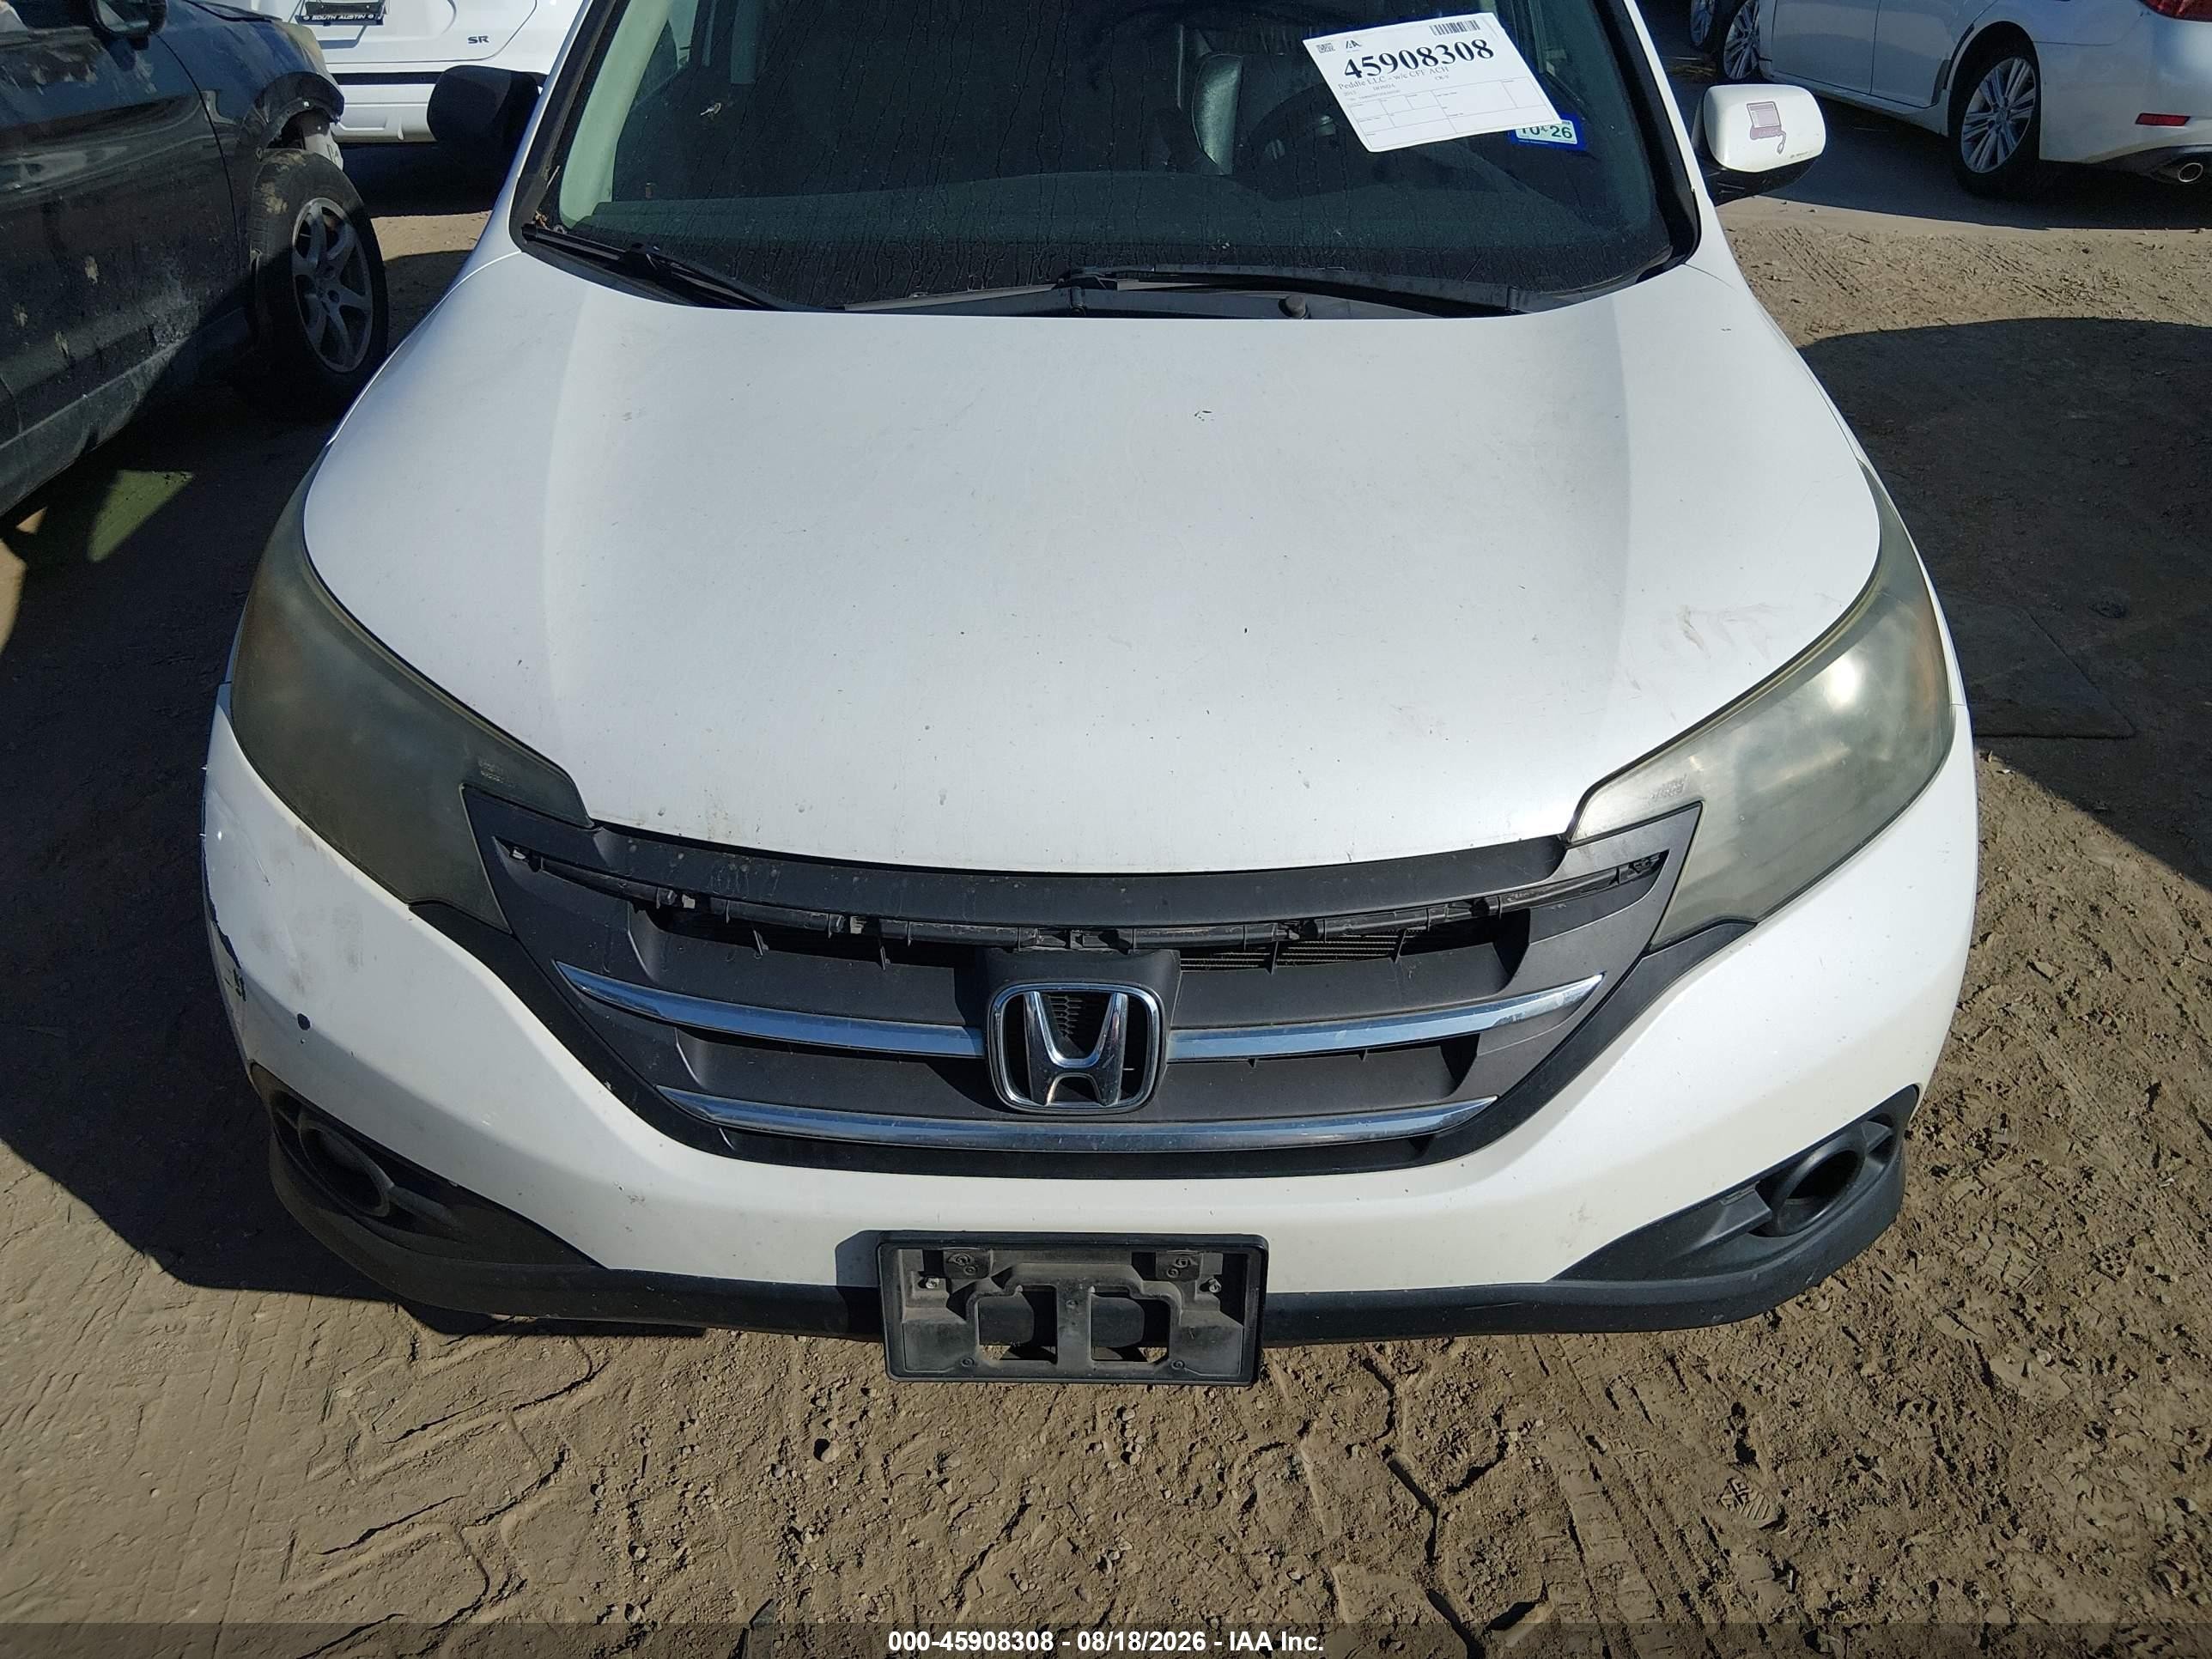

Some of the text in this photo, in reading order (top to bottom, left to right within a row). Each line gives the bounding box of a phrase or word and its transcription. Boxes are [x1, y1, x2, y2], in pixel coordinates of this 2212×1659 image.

[468, 35, 489, 44] SR
[1345, 39, 1494, 79] 45908308
[1338, 79, 1366, 90] Peddle
[1549, 125, 1573, 138] 26
